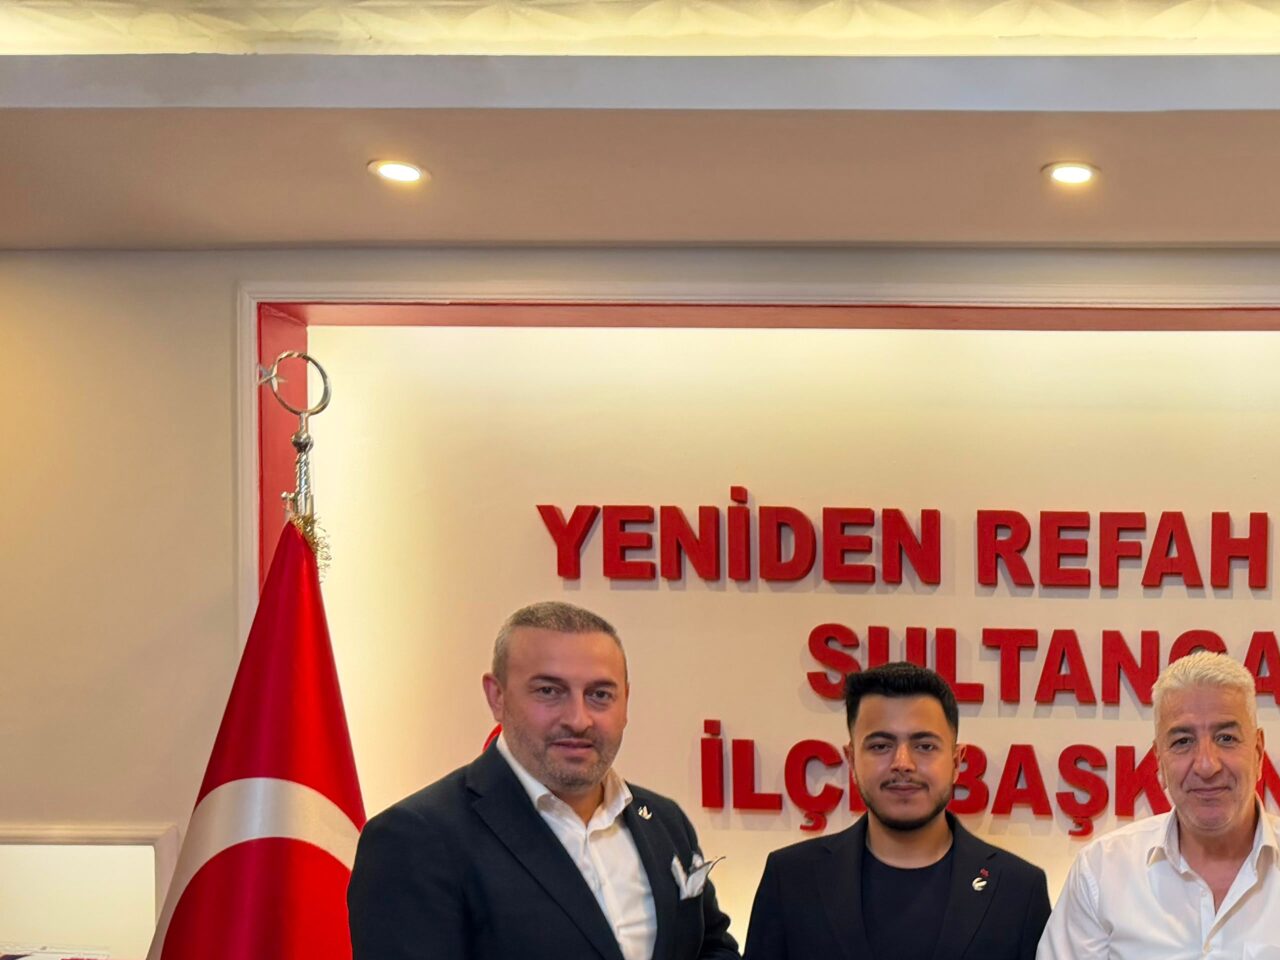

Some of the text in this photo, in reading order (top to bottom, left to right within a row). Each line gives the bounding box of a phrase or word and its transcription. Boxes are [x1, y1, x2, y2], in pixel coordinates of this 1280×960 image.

[536, 486, 942, 584] YENİDEN
[976, 509, 1269, 590] REFAH
[700, 719, 868, 832] İLÇ
